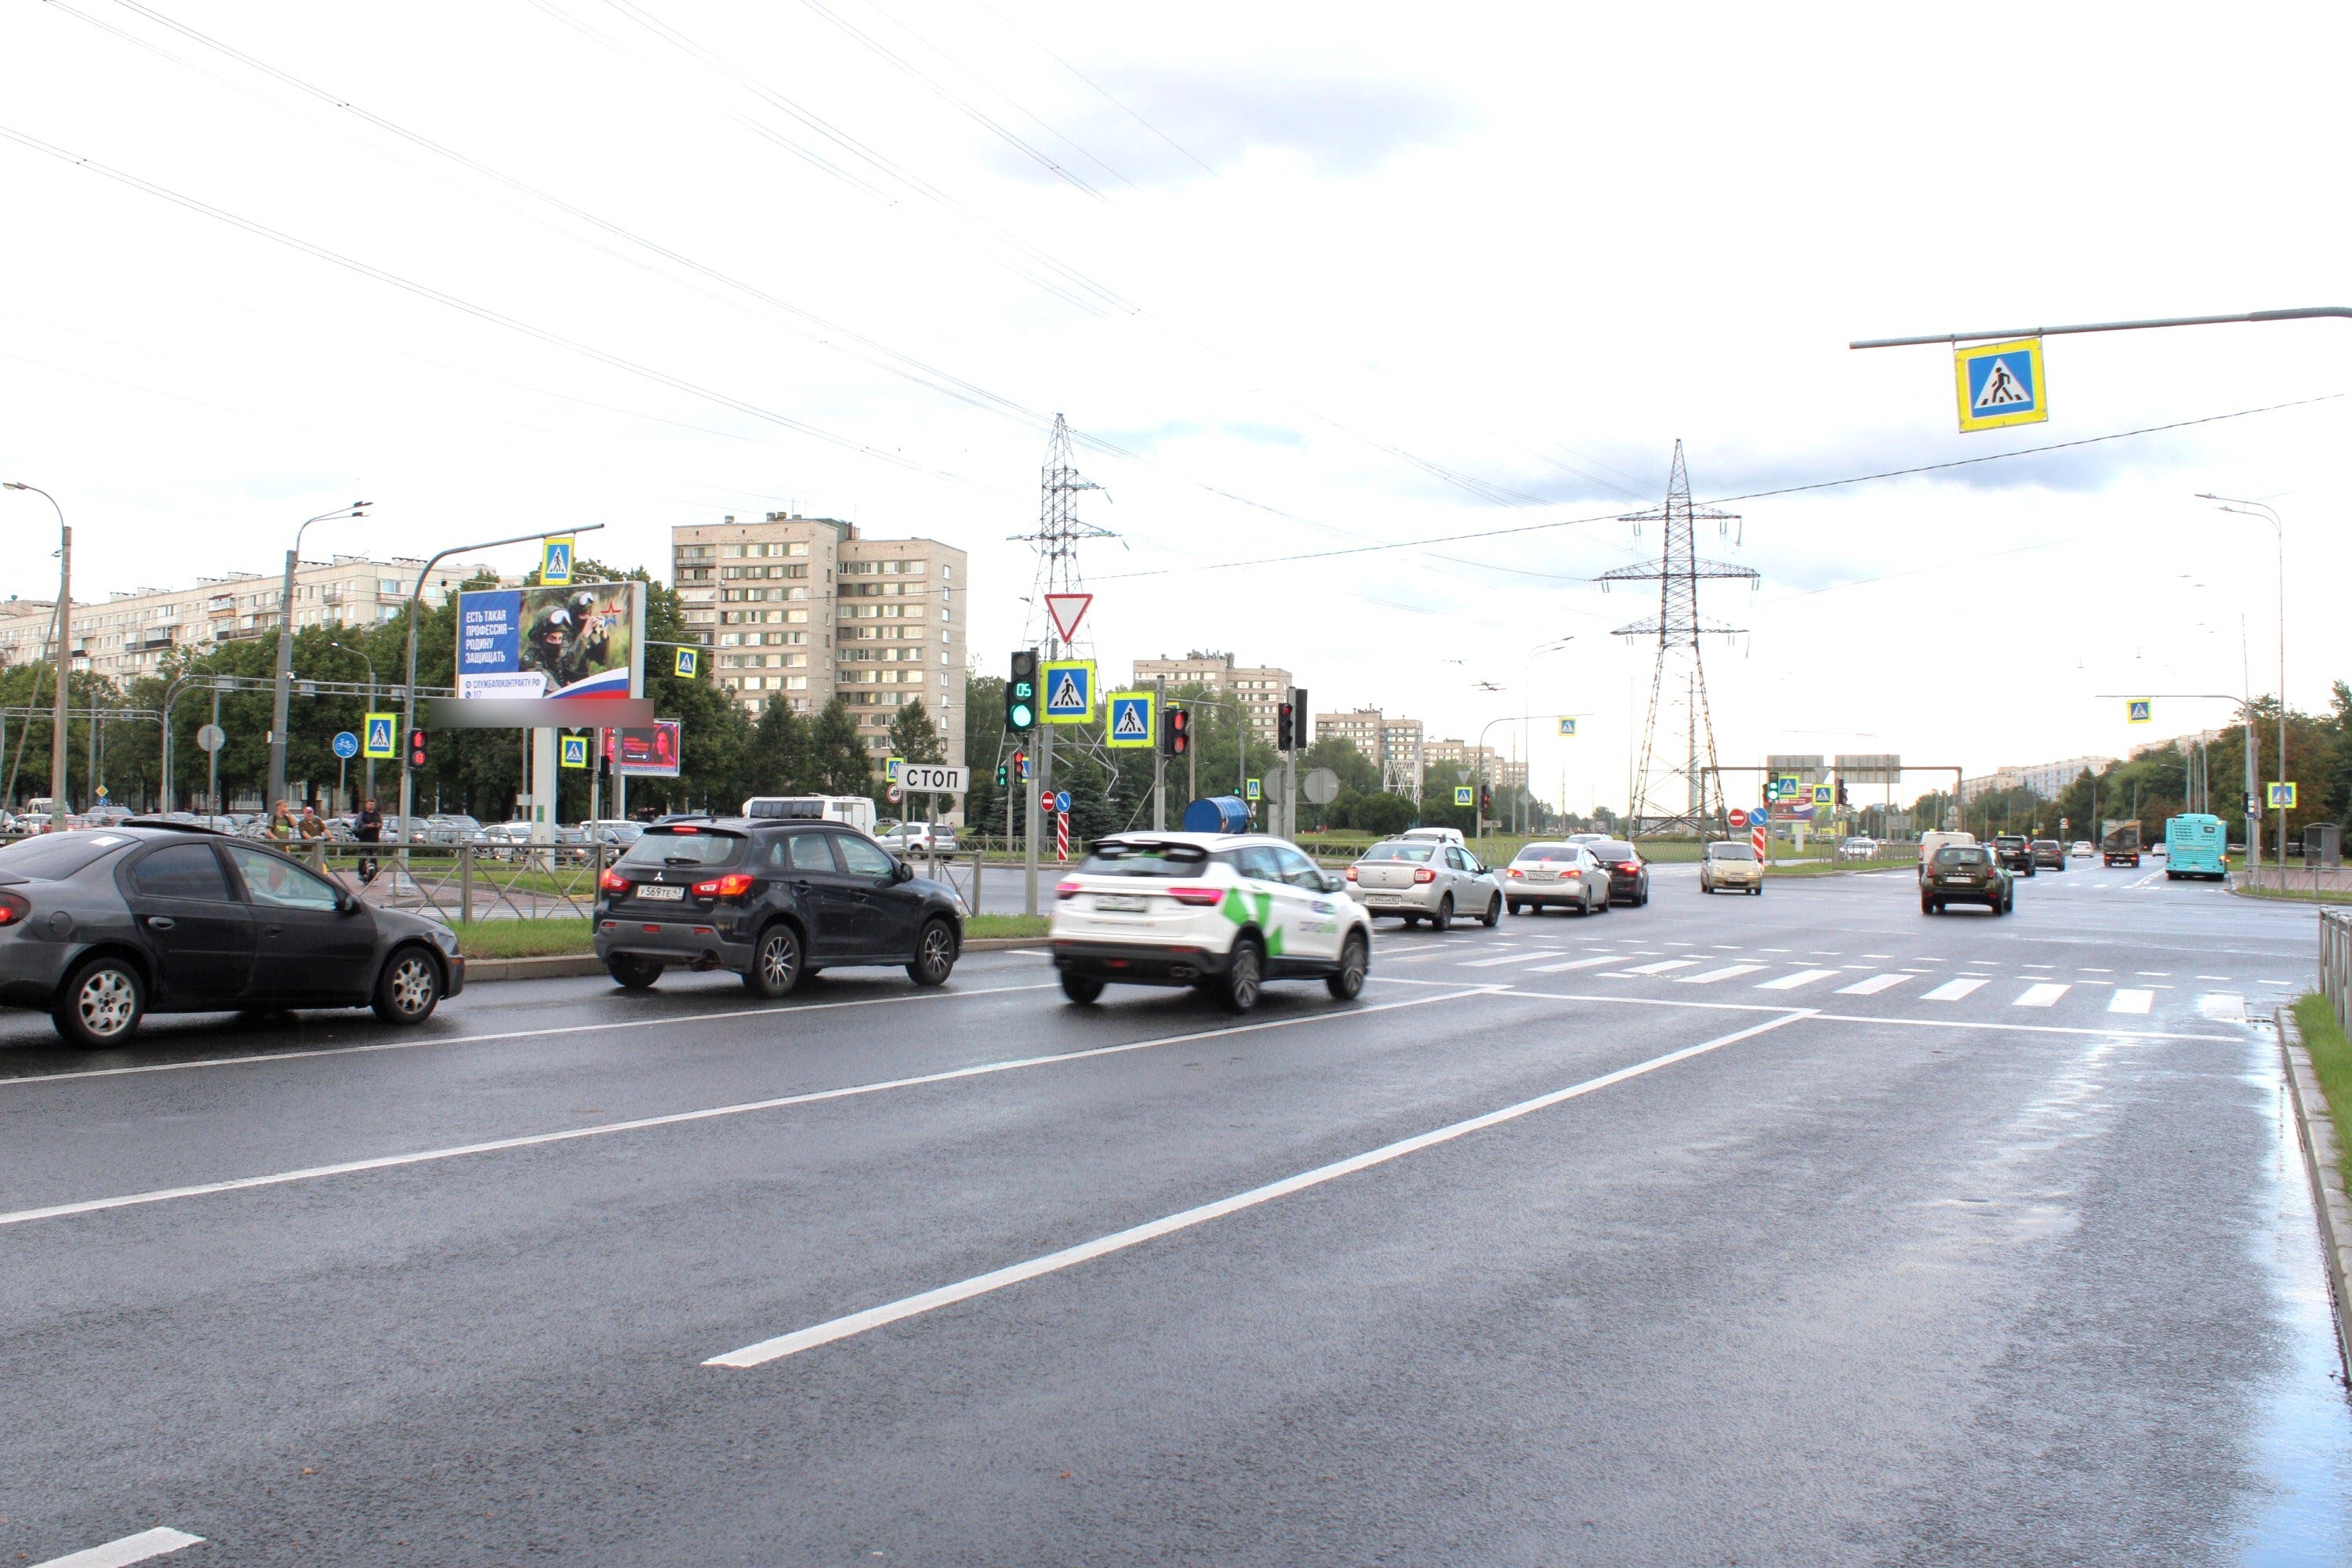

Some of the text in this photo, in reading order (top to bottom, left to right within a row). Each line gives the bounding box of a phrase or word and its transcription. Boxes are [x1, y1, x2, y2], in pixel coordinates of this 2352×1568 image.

[466, 610, 506, 622] ЕСТЬ ТАКАЯ
[466, 623, 507, 637] ПРОФЕССИЯ
[466, 637, 494, 651] РОДИНУ
[465, 651, 506, 664] ЗАЩИЩАТЬ
[1016, 683, 1032, 697] 05
[906, 769, 958, 788] СТОП
